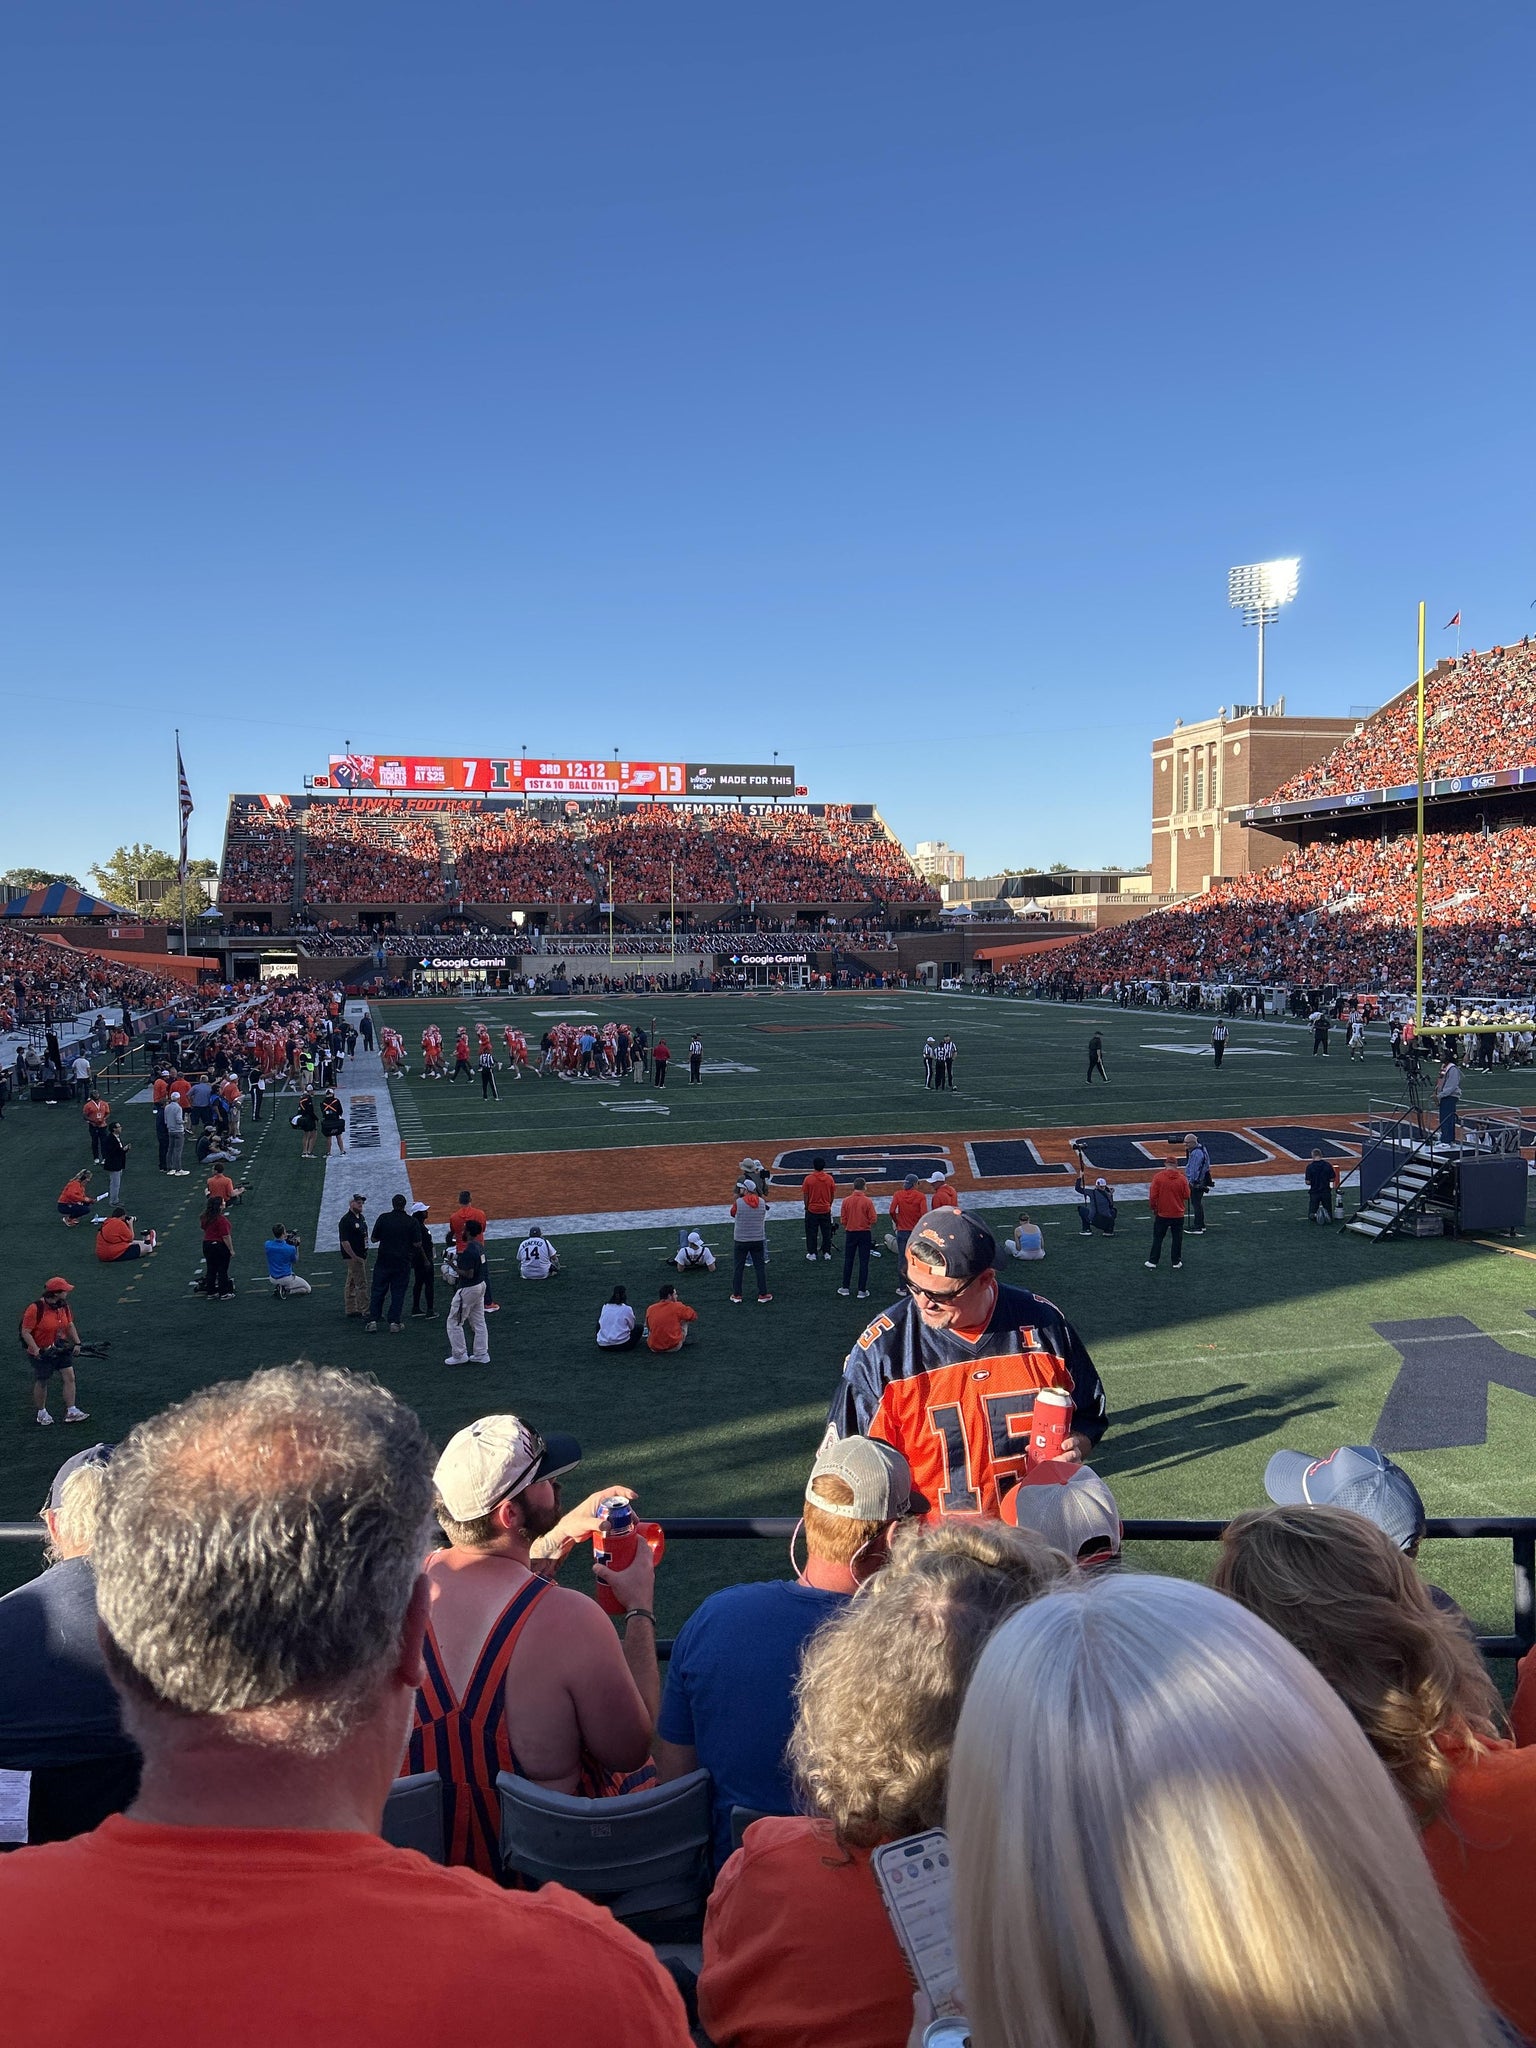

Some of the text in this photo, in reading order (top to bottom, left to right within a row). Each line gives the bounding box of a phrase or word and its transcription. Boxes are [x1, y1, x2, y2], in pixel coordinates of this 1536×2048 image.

[463, 761, 477, 788] 7
[539, 763, 605, 777] 3RD 12:12
[315, 777, 328, 787] 25
[529, 780, 564, 789] 1ST & 10
[658, 765, 682, 792] 13
[719, 775, 792, 786] MADE FOR THIS
[569, 780, 616, 791] BALL ON 11
[796, 787, 808, 796] 25
[432, 957, 506, 969] Google Gemini
[741, 954, 807, 965] Google Gemini
[525, 1246, 540, 1260] 14
[857, 1314, 895, 1351] 5
[1019, 1325, 1041, 1349] I
